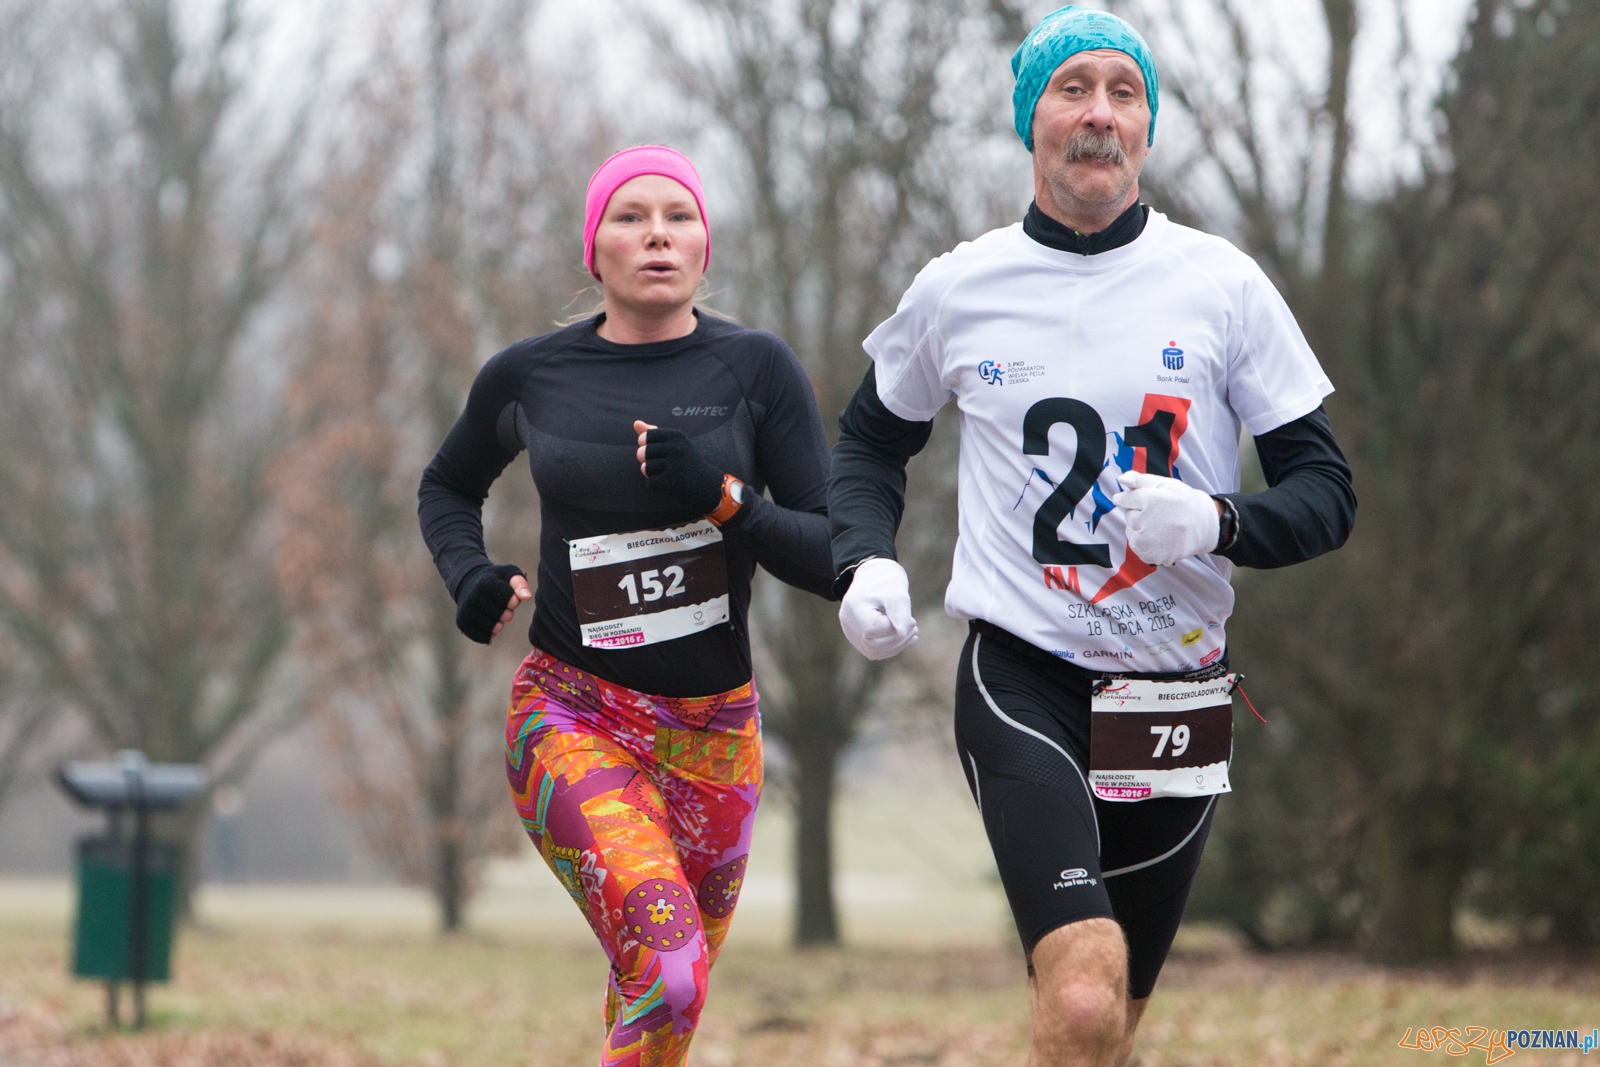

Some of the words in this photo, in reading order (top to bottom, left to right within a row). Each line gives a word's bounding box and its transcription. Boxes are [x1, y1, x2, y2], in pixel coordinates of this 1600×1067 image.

[1007, 365, 1045, 373] PÓŁMARATON
[684, 406, 728, 416] HI-TEC
[617, 565, 686, 605] 152
[587, 623, 624, 633] NAJSŁODSZY
[1086, 620, 1102, 636] 18
[1109, 620, 1144, 636] LIPCA
[1147, 614, 1176, 632] 2015
[610, 627, 642, 636] POZNANIU
[1083, 650, 1134, 659] GARMIN
[1157, 686, 1227, 701] BIEGCZEKOLADOWY.PL
[1150, 724, 1191, 758] 79
